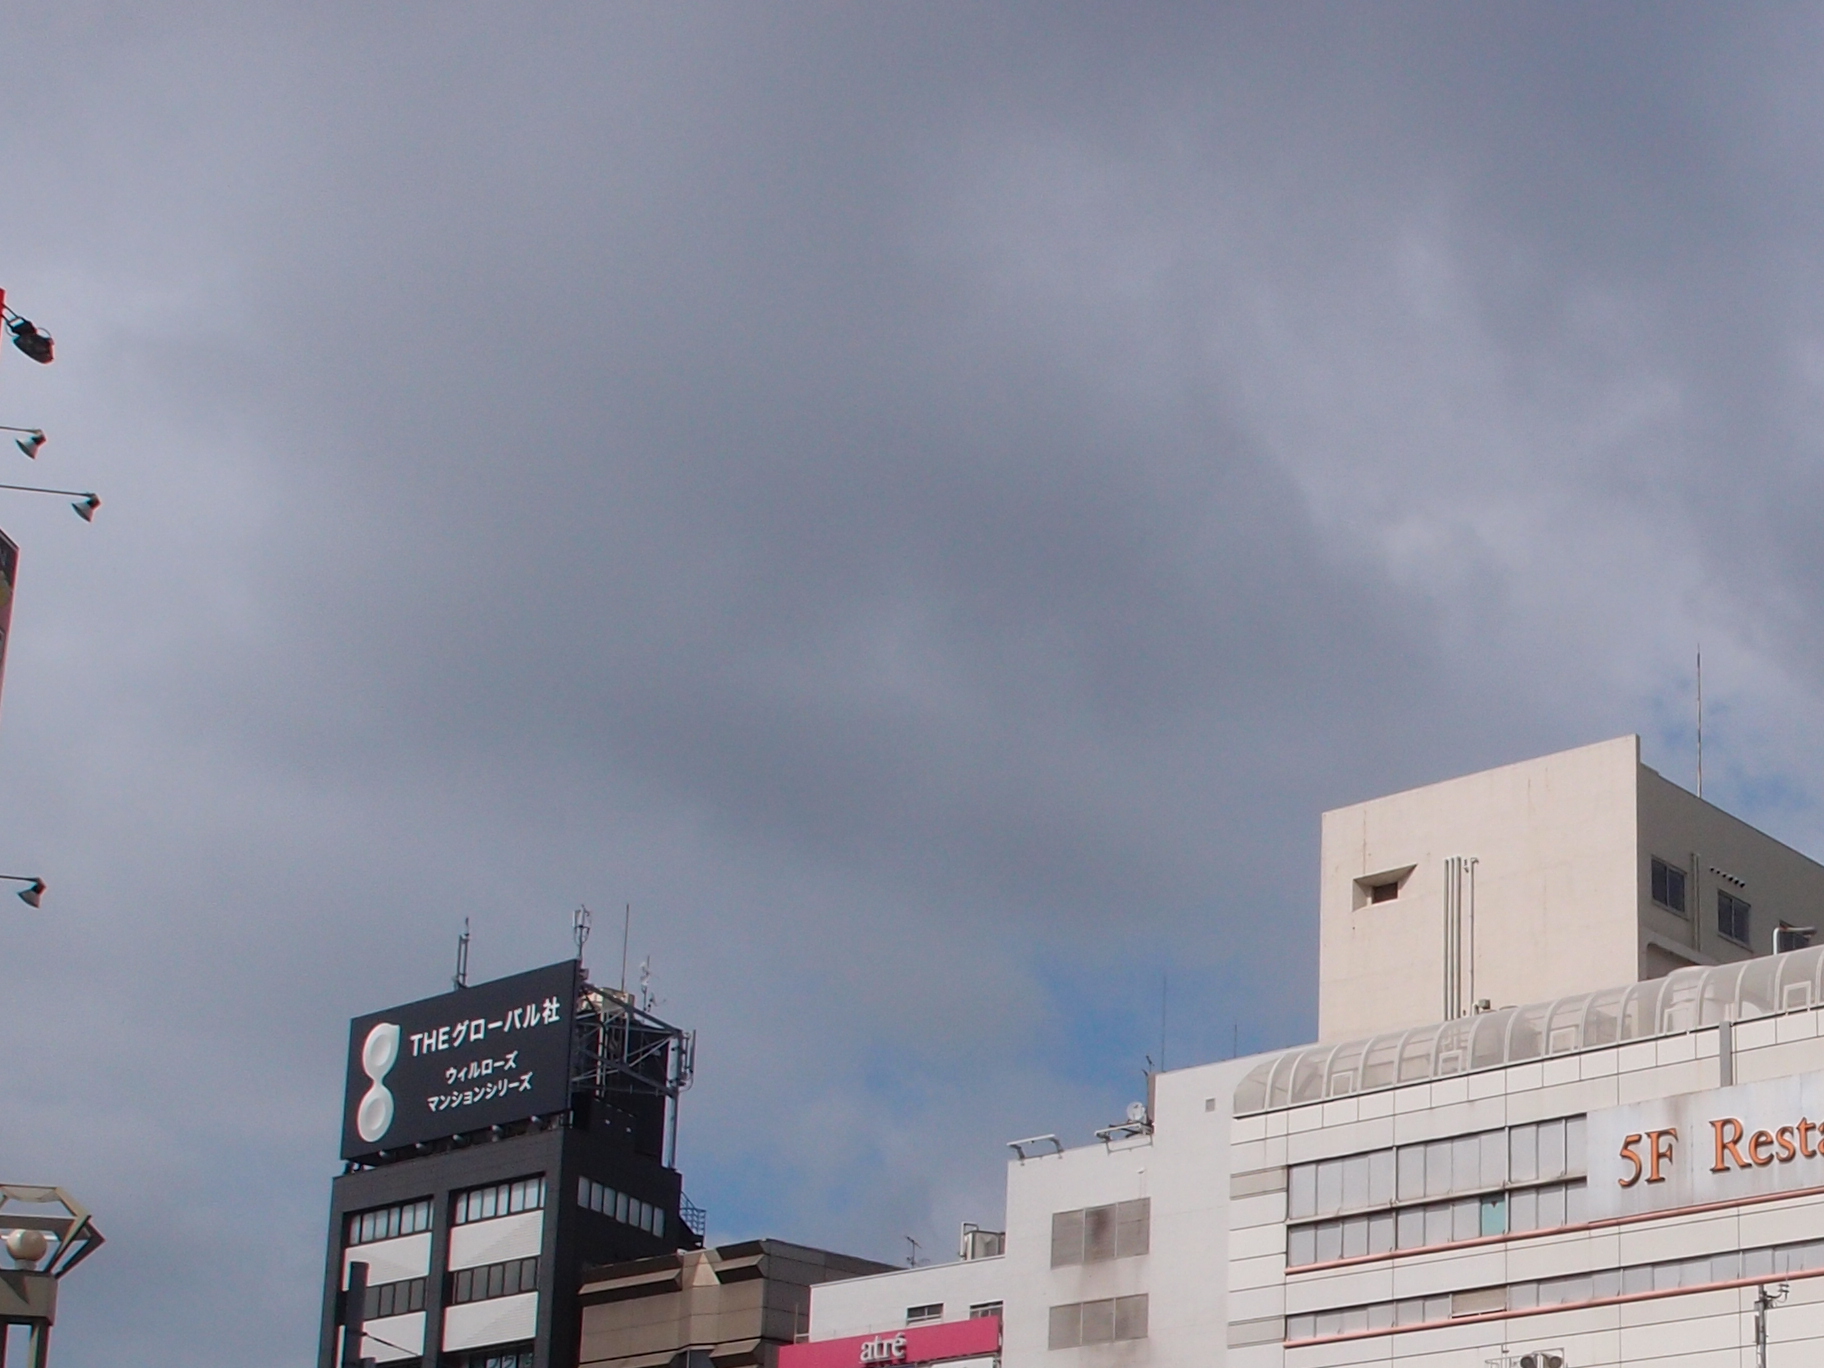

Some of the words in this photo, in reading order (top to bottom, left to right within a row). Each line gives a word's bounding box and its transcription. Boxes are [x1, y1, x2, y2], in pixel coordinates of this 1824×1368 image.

[410, 996, 561, 1057] THEグローバル社
[445, 1050, 519, 1085] ウィルローズ
[426, 1071, 533, 1112] マンションシリーズ
[1618, 1127, 1679, 1188] 5F
[860, 1332, 907, 1363] atré
